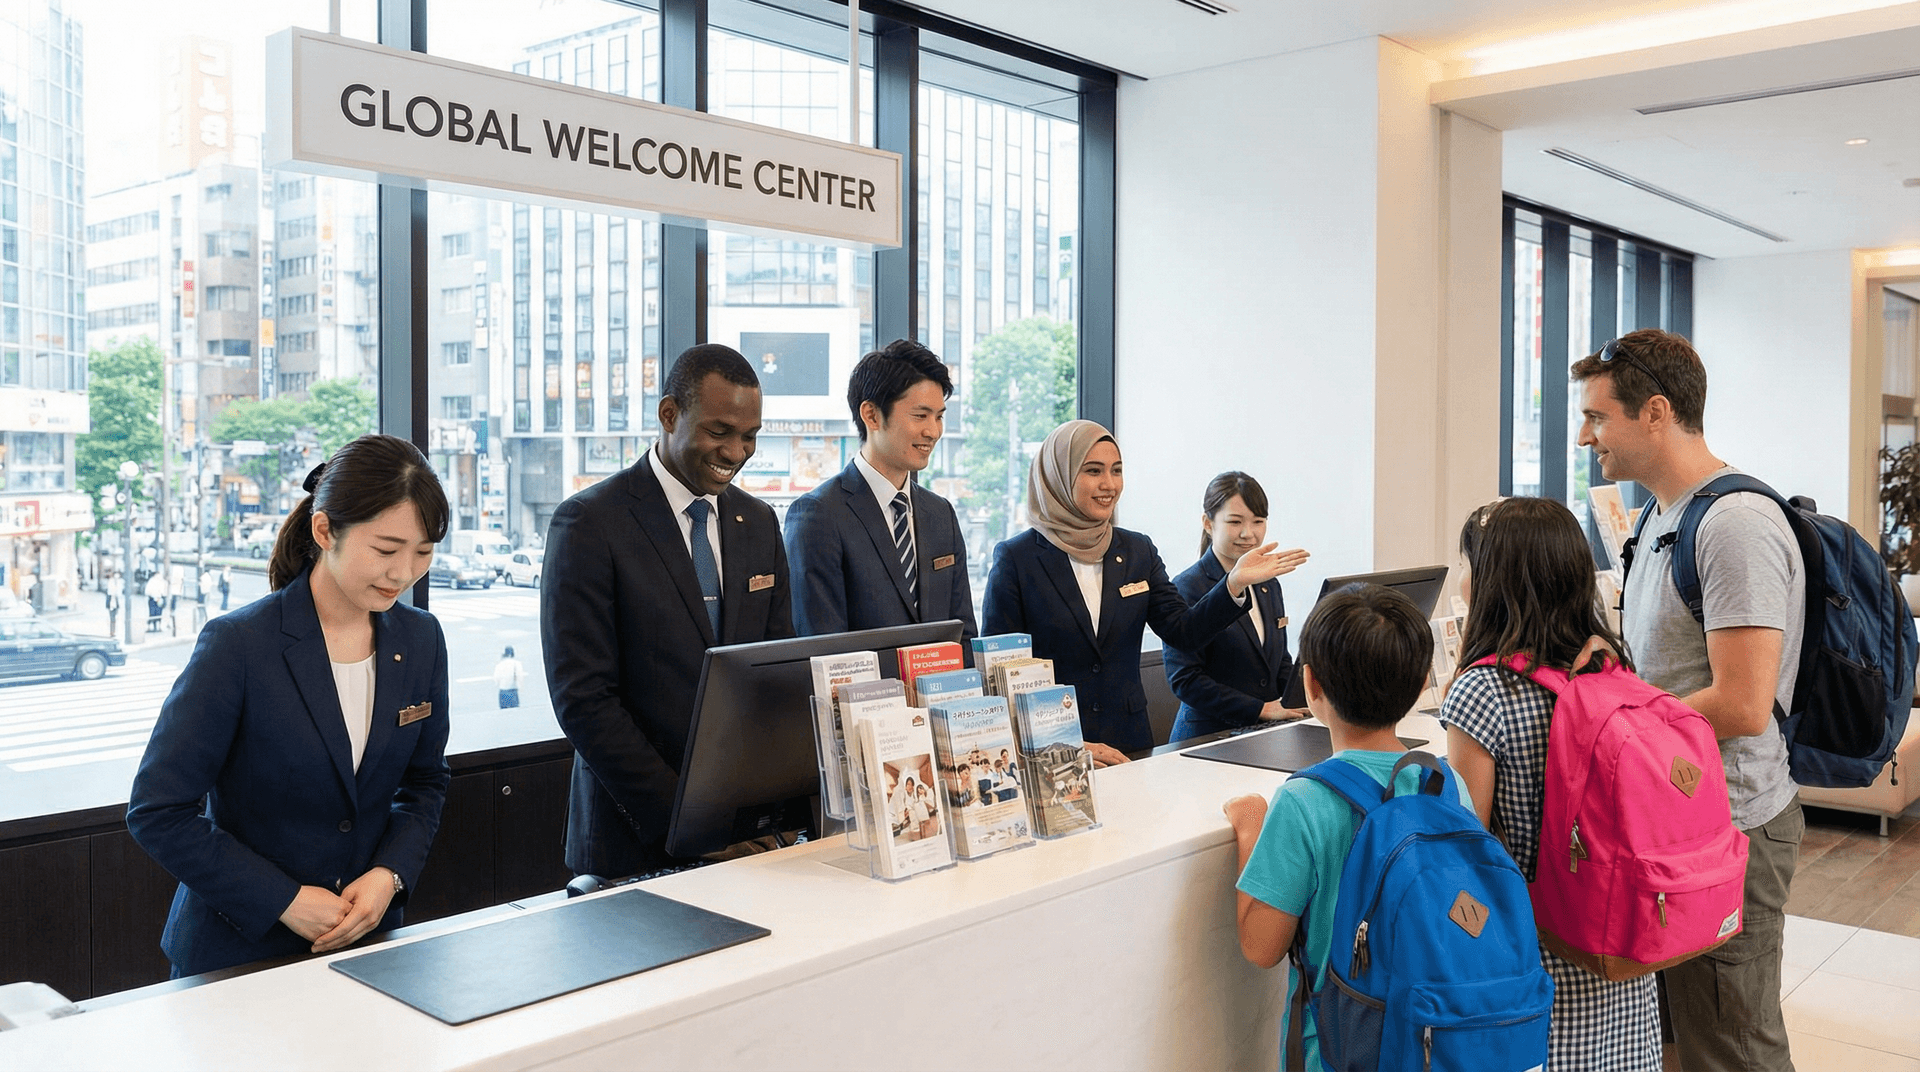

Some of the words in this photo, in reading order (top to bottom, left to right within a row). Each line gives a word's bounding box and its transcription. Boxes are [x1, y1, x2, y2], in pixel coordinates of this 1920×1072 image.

[341, 84, 532, 154] GLOBAL
[543, 120, 742, 189] WELCOME
[754, 161, 876, 212] CENTER
